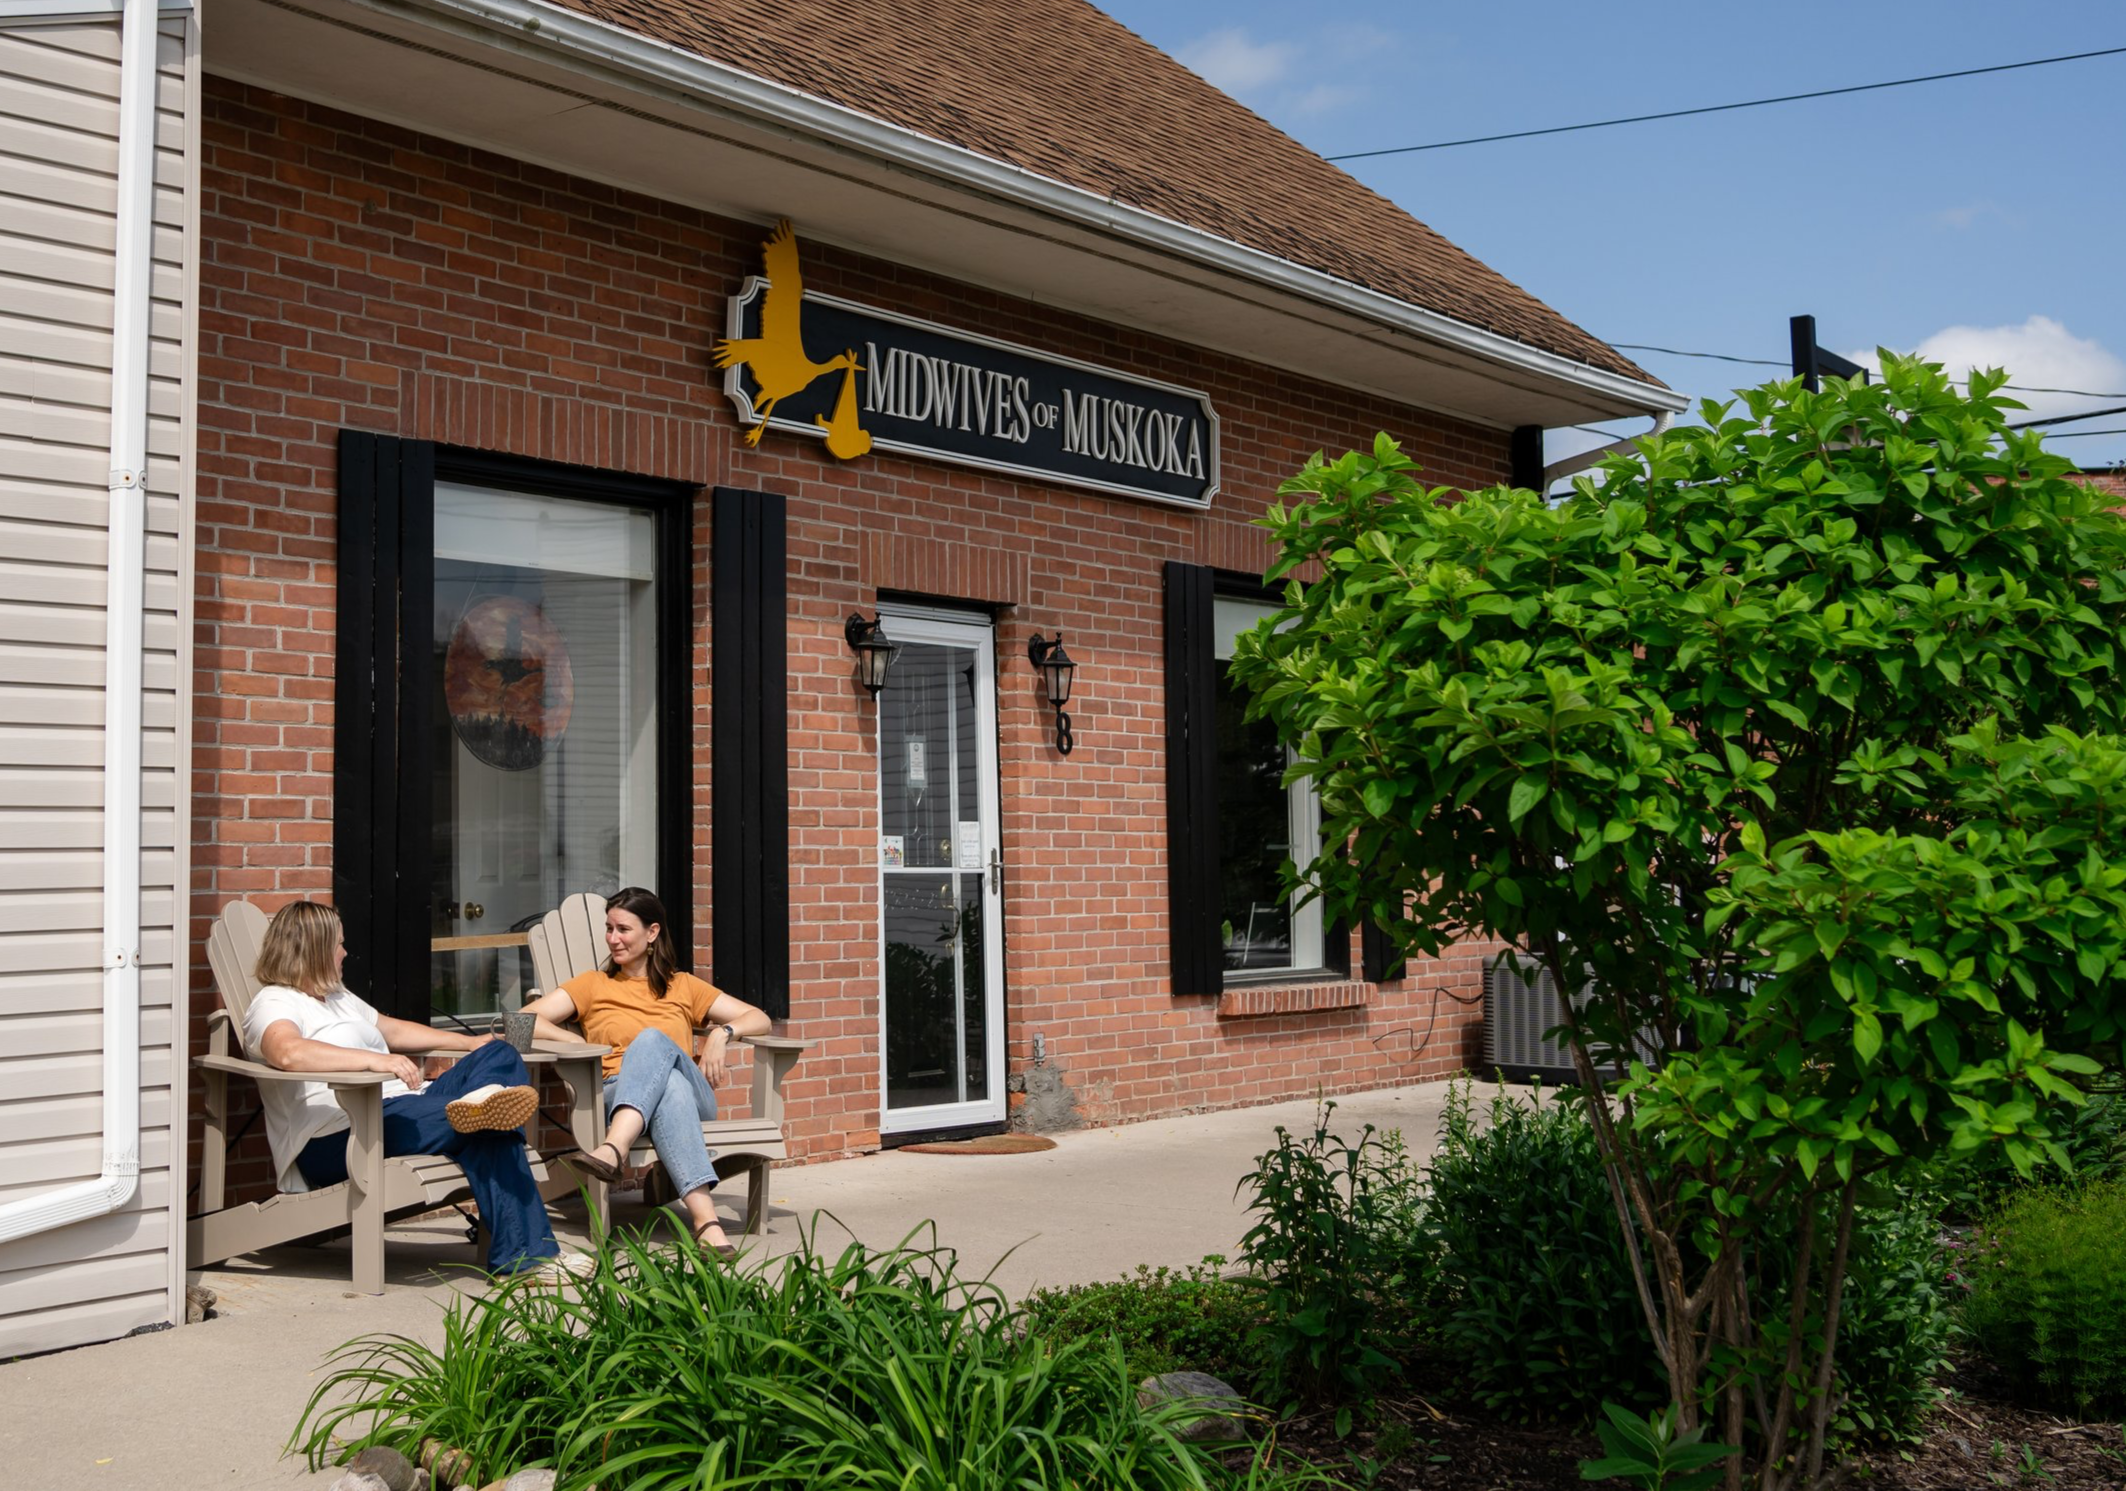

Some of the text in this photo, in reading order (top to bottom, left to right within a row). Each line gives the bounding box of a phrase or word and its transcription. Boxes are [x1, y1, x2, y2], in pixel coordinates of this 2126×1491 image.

[863, 342, 1205, 480] MIDWIVES OF MUSKOKA
[1057, 712, 1073, 755] 8
